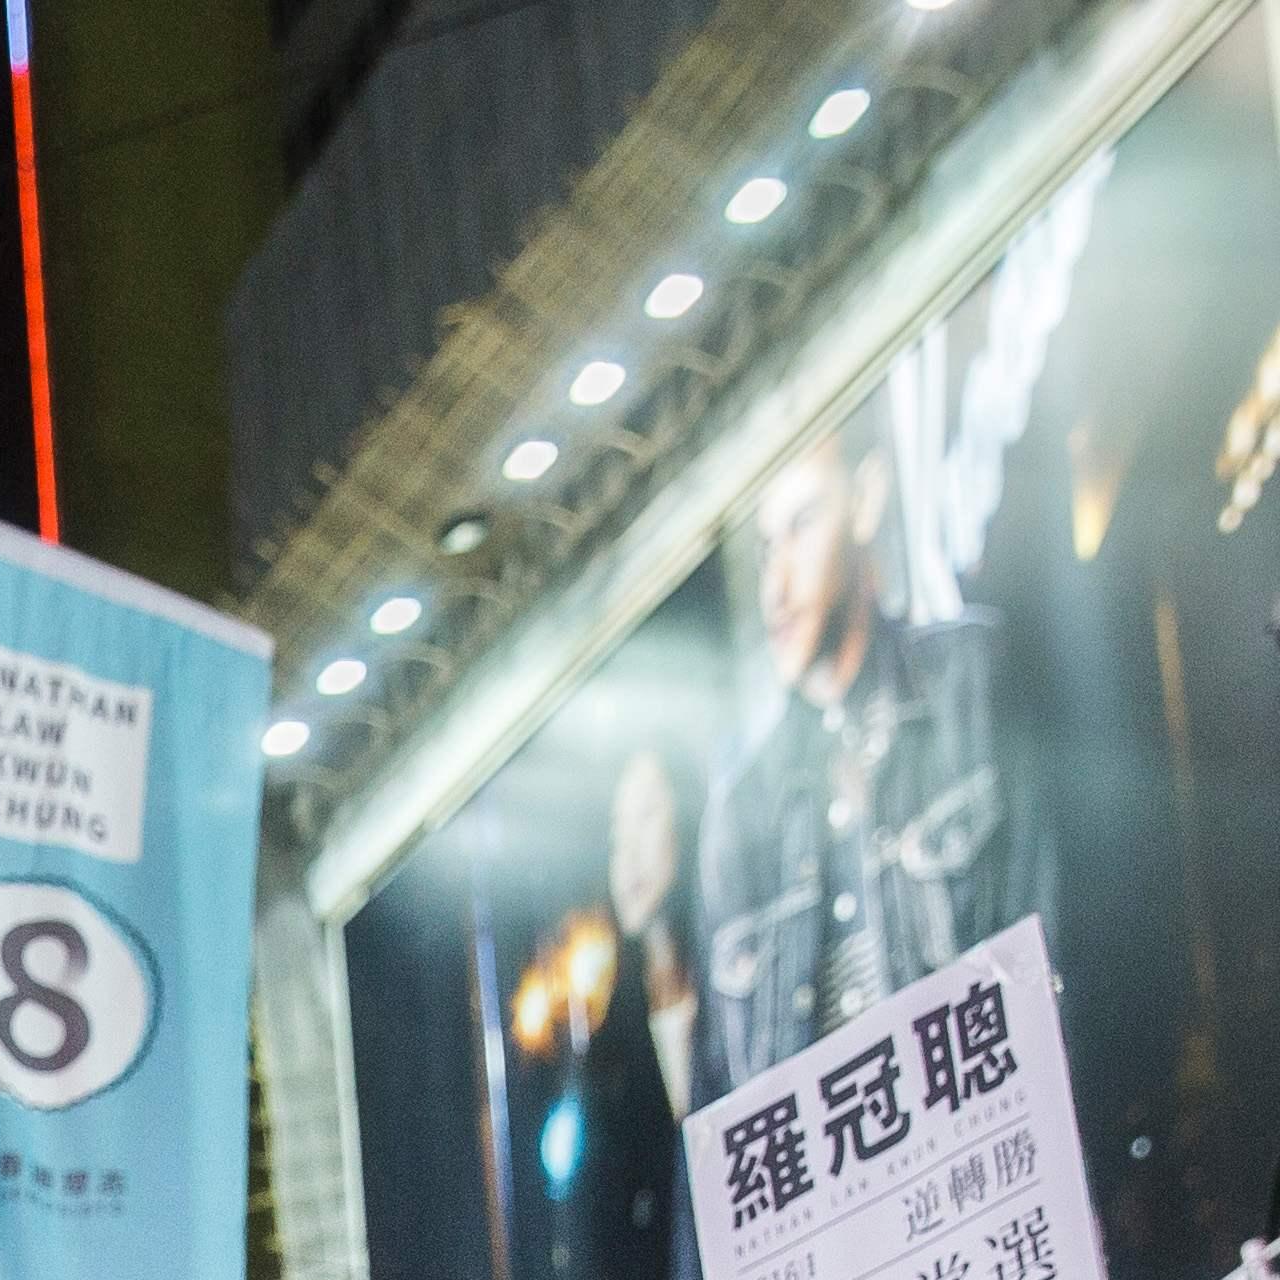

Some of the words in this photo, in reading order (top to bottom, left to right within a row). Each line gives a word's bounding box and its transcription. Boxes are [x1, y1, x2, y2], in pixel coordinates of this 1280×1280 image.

[721, 977, 1021, 1230] 羅冠聰
[903, 1127, 1039, 1243] 逆轉勝
